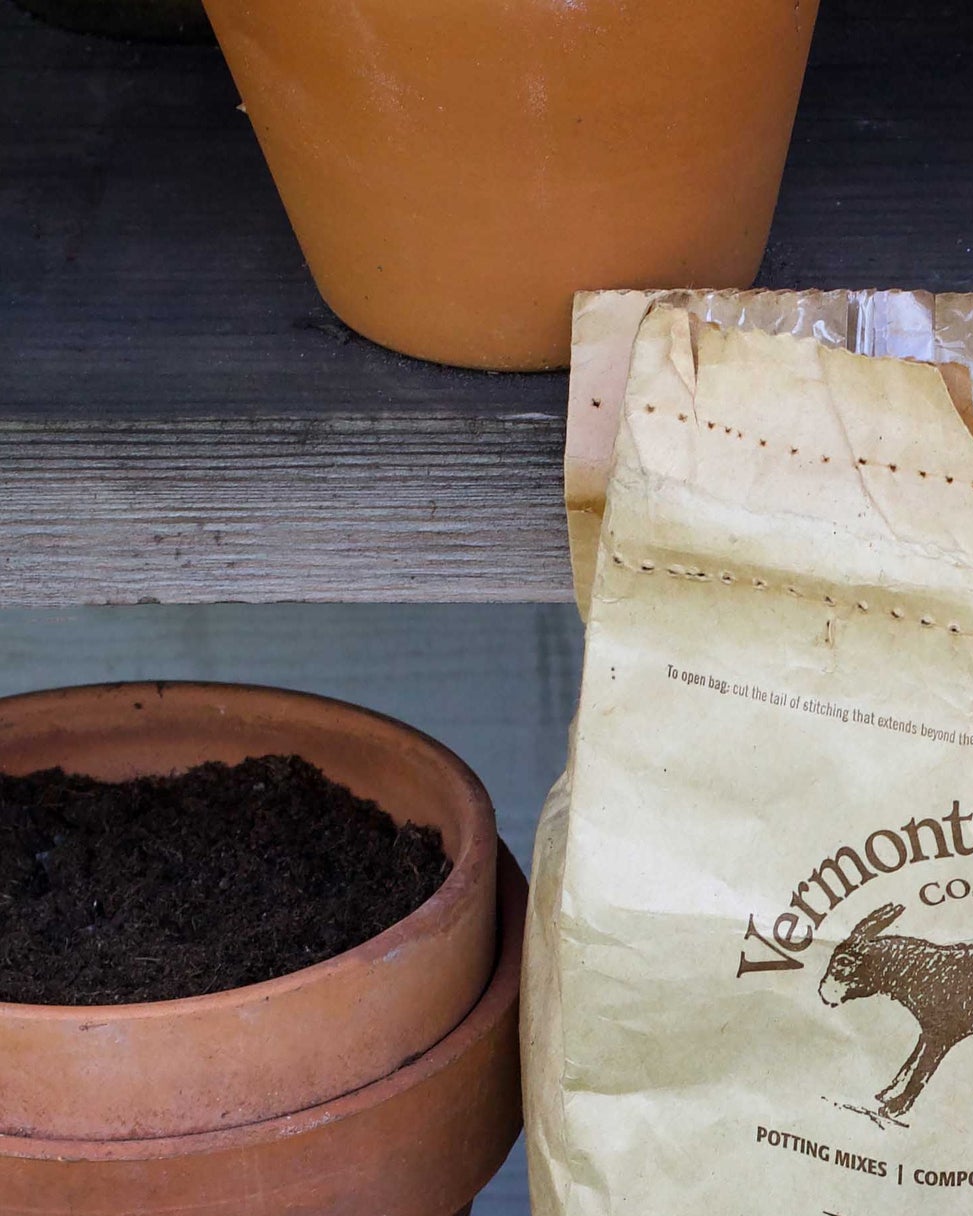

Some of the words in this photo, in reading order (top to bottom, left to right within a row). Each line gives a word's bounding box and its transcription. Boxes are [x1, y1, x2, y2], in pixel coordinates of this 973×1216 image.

[667, 664, 678, 679] To
[681, 671, 706, 686] open
[732, 682, 749, 698] cut
[752, 686, 767, 702] the
[769, 691, 787, 706] tail
[789, 696, 801, 709] of
[803, 698, 849, 723] stitching
[852, 708, 875, 726] that
[877, 715, 917, 735] extends
[921, 723, 955, 744] beyond
[756, 1126, 830, 1162] POTTING
[834, 1150, 888, 1177] MIXES
